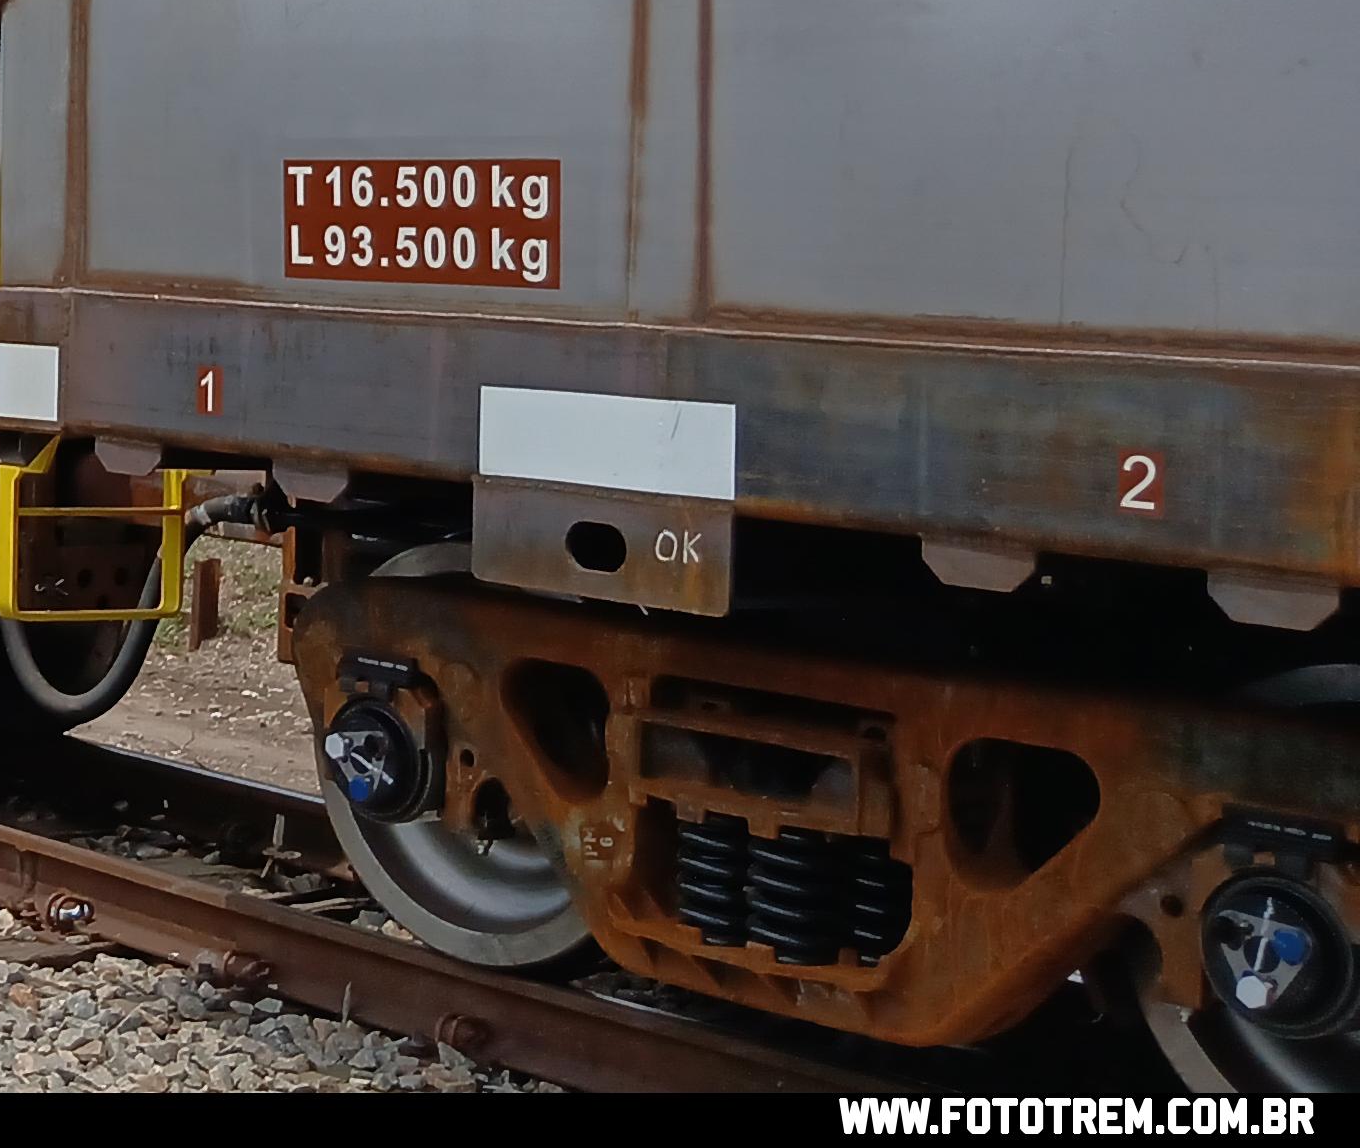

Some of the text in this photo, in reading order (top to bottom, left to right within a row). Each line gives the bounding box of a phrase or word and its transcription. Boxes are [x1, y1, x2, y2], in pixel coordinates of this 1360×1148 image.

[287, 165, 550, 219] T 16.500 kg
[290, 225, 549, 282] L 93.500 kg
[200, 370, 214, 413] 1
[1119, 455, 1157, 511] 2
[655, 530, 702, 563] OK
